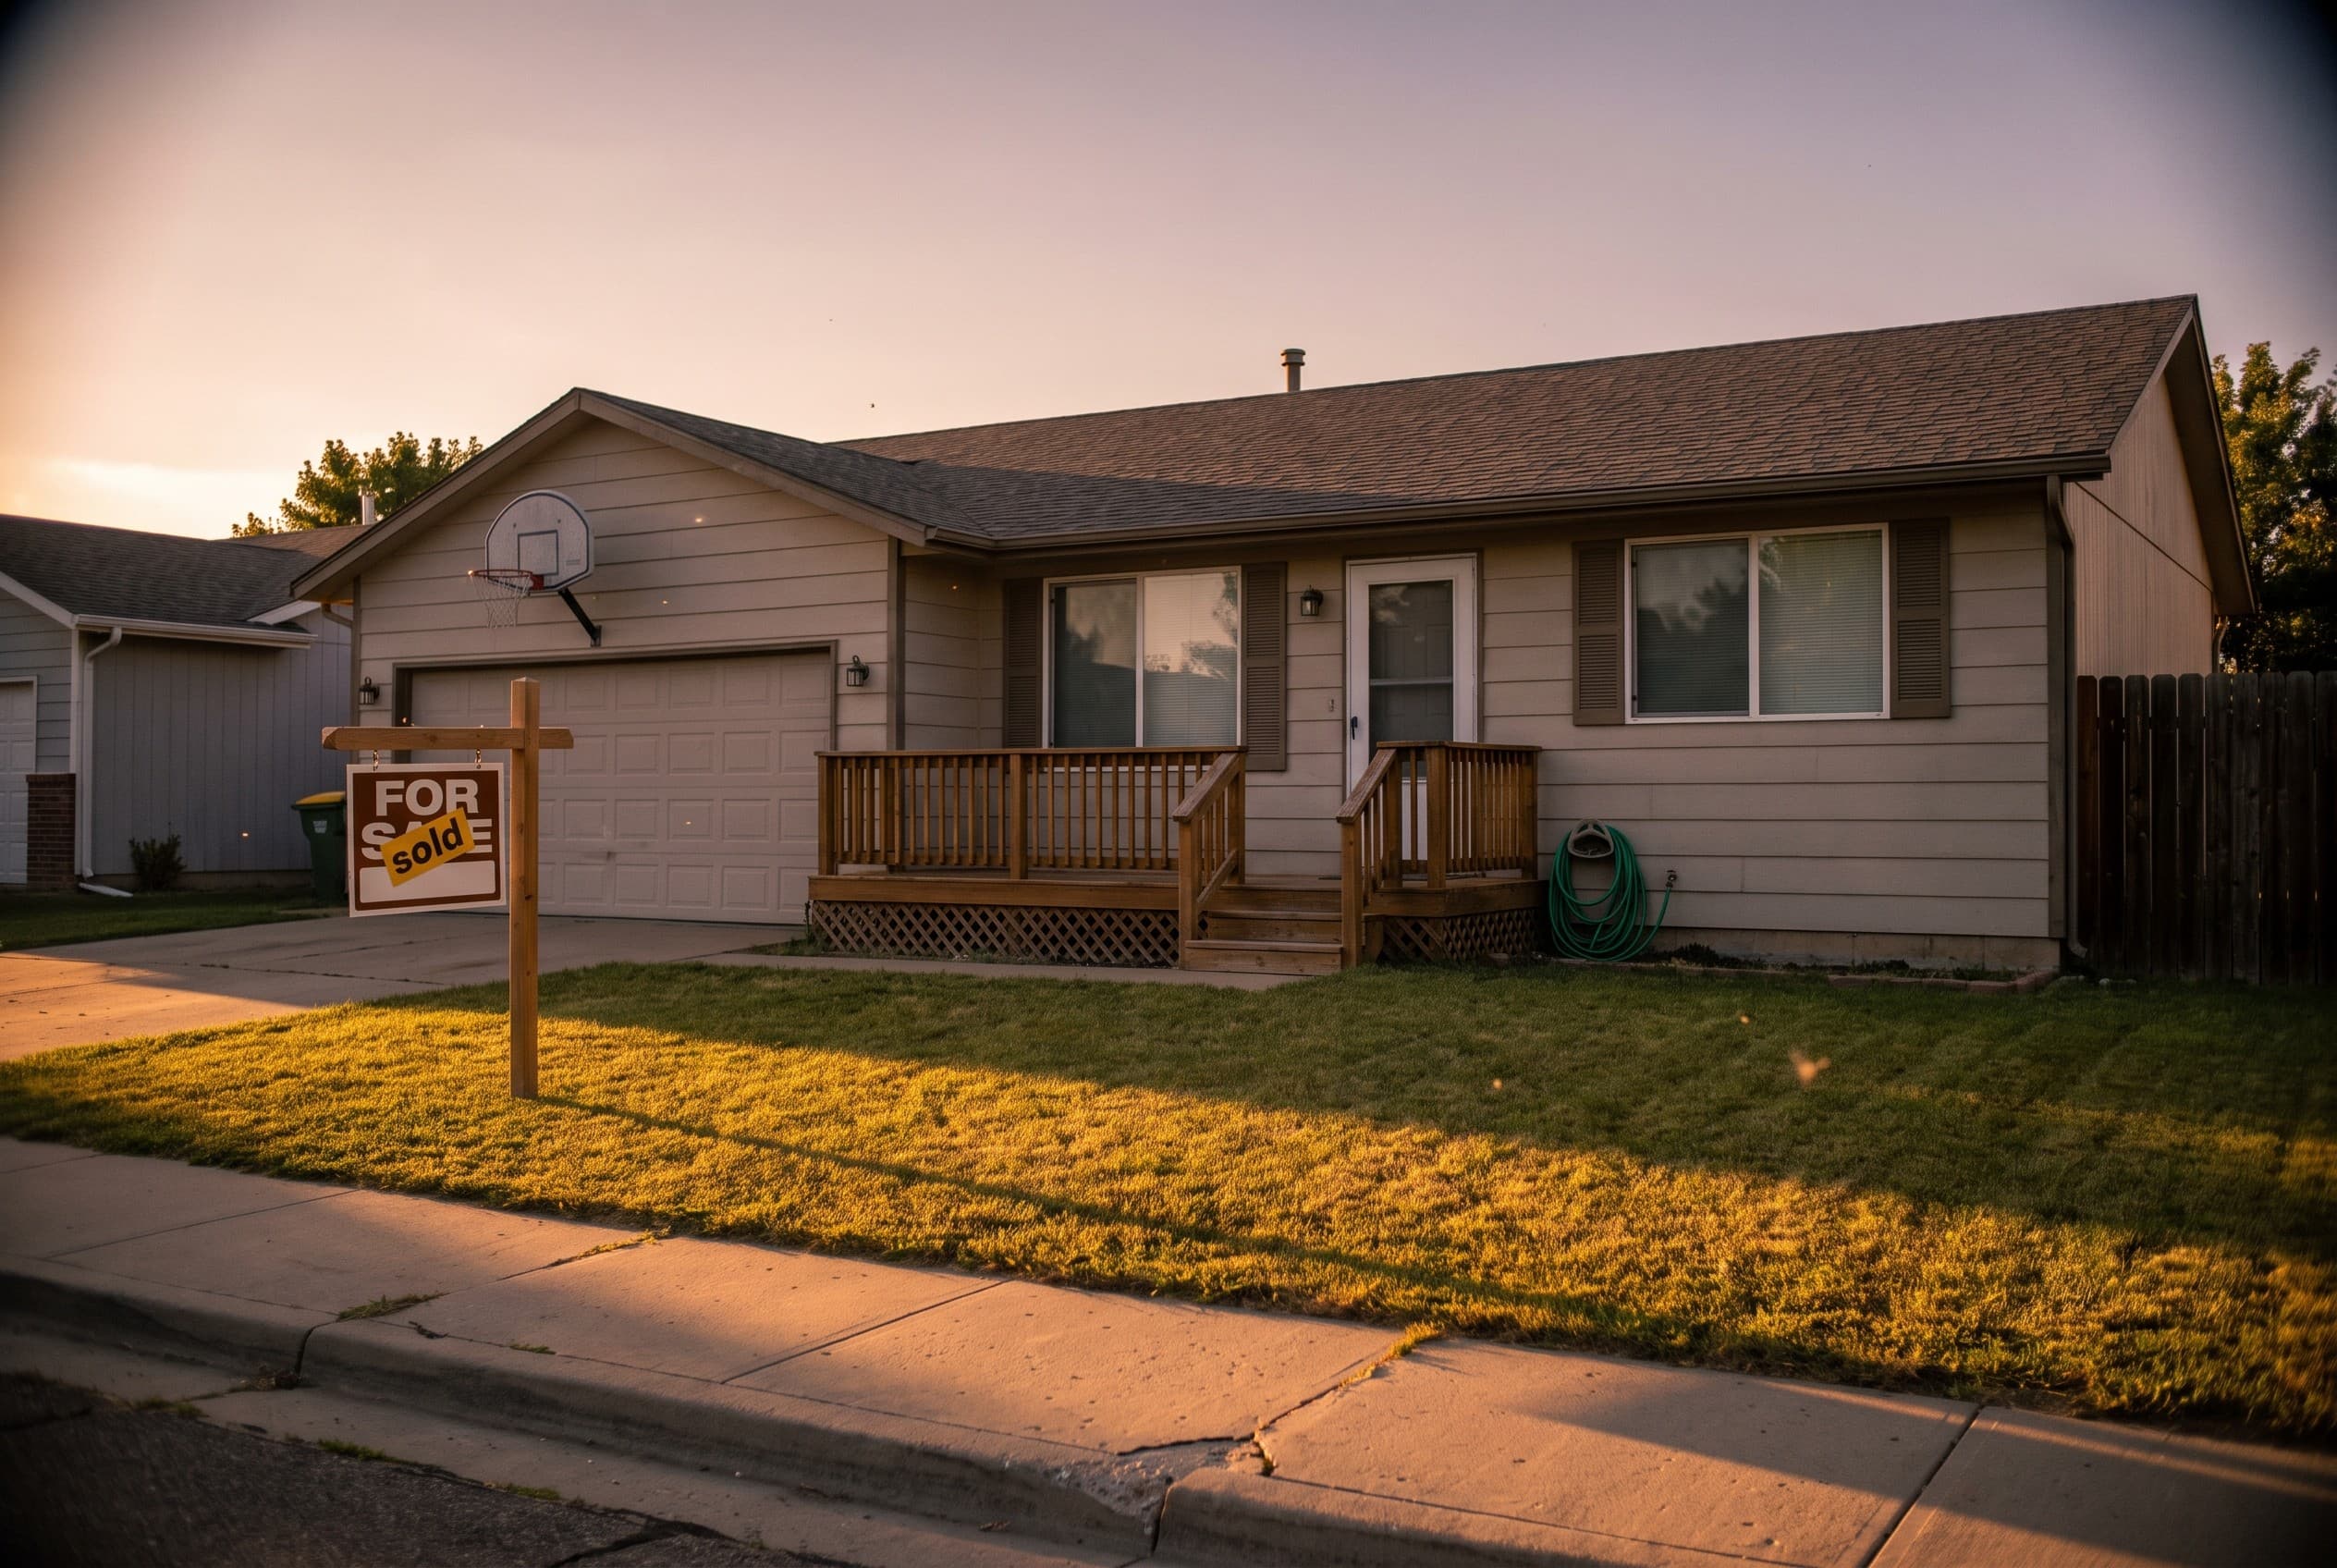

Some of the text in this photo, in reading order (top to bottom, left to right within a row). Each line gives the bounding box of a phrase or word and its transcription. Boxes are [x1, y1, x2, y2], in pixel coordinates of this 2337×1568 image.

[375, 778, 479, 816] FOR
[361, 818, 493, 860] SE
[392, 816, 464, 875] sold
